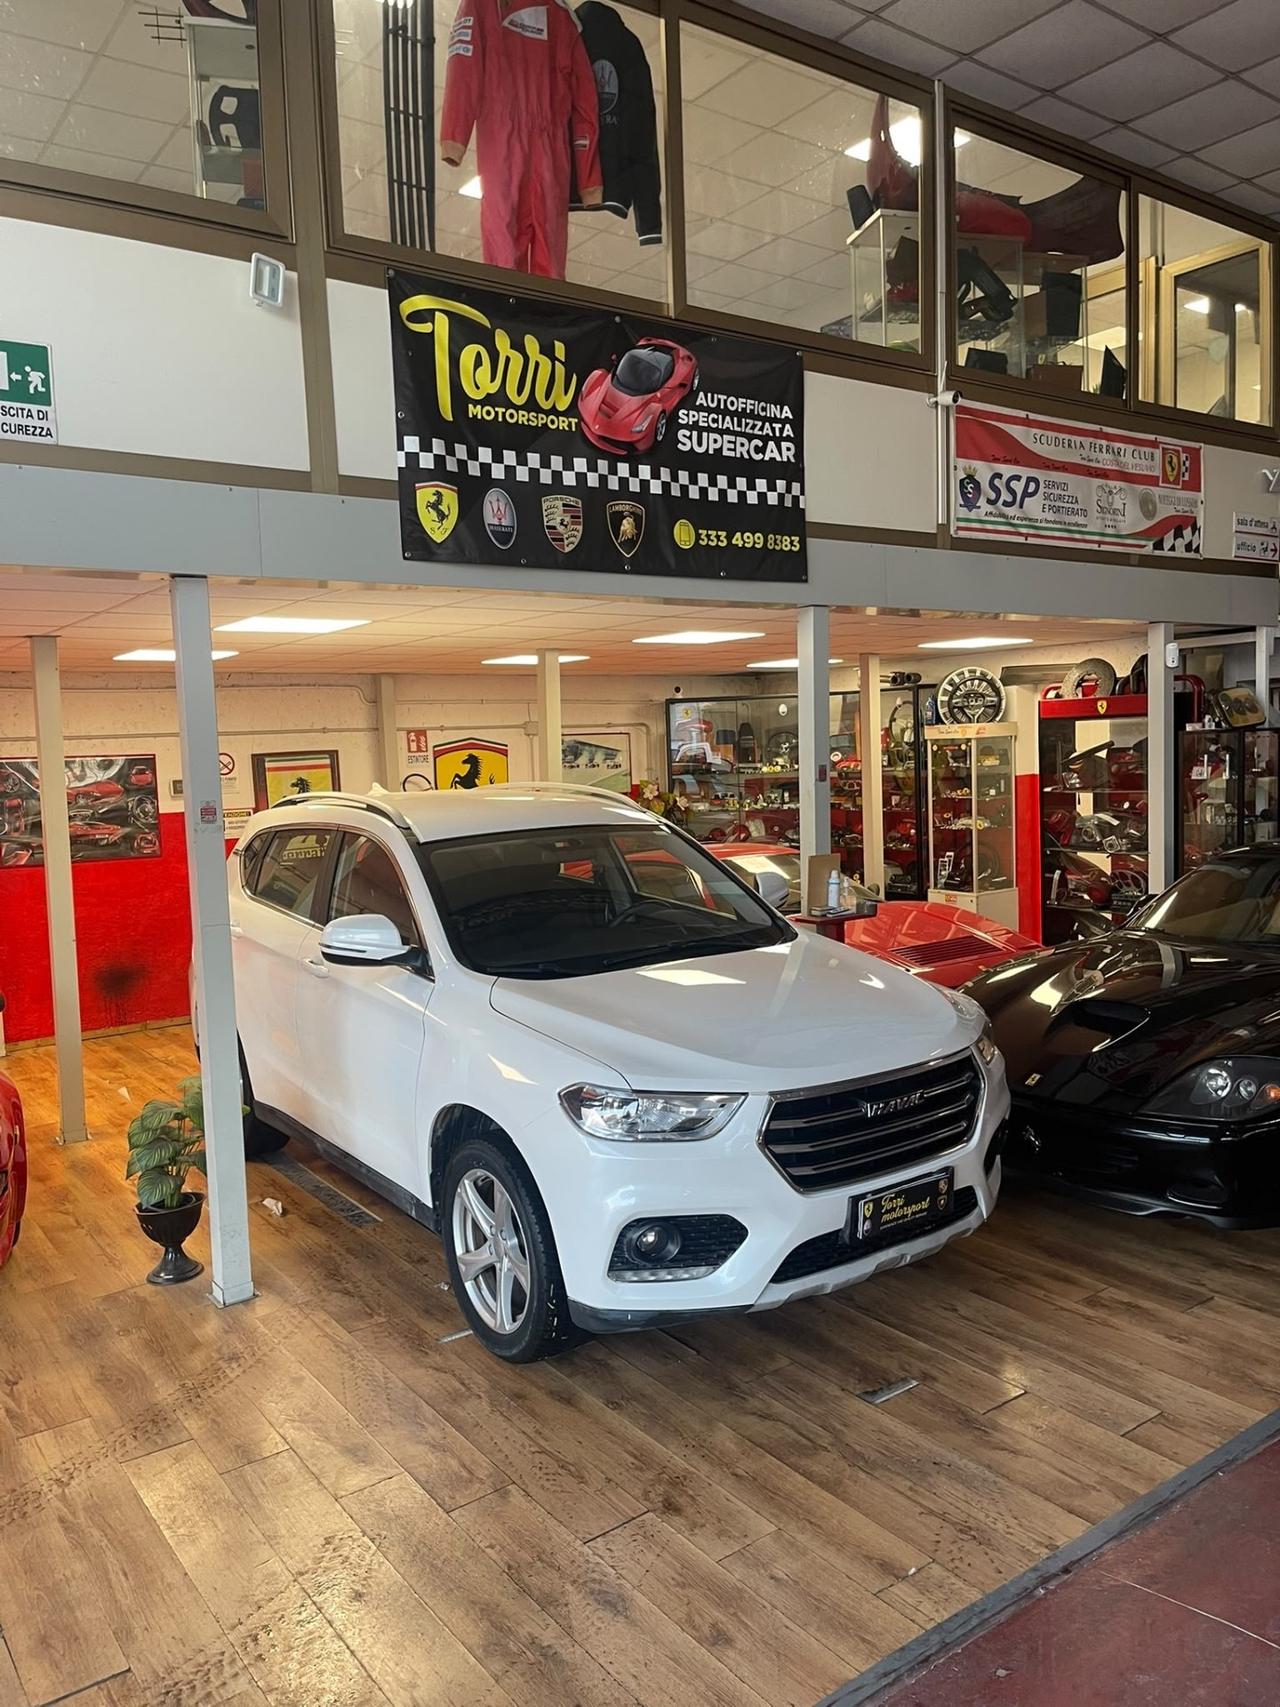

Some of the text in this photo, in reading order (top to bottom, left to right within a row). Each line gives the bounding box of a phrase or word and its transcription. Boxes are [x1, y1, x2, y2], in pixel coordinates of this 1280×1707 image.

[399, 294, 578, 421] Torri
[695, 391, 793, 419] AUTOFFICINA
[37, 410, 49, 421] DI
[468, 403, 578, 432] MOTORSPORT
[677, 409, 795, 438] SPECIALIZZATA
[1, 423, 54, 438] CUREZZA
[676, 429, 796, 463] SUPERCAR
[1033, 433, 1155, 462] SCUDERIA FERRARI CLUB
[986, 472, 1040, 509] SSP
[1043, 479, 1069, 491] SERVIZI
[543, 496, 581, 505] PORSCHE
[1043, 492, 1079, 505] SICUREZZA
[1042, 505, 1088, 518] E PORTIERATO
[1237, 517, 1248, 526] sala
[698, 529, 801, 552] 333 499 8383
[1237, 541, 1256, 552] ufficio
[881, 1194, 905, 1212] Torri
[881, 1196, 930, 1223] motorsport
